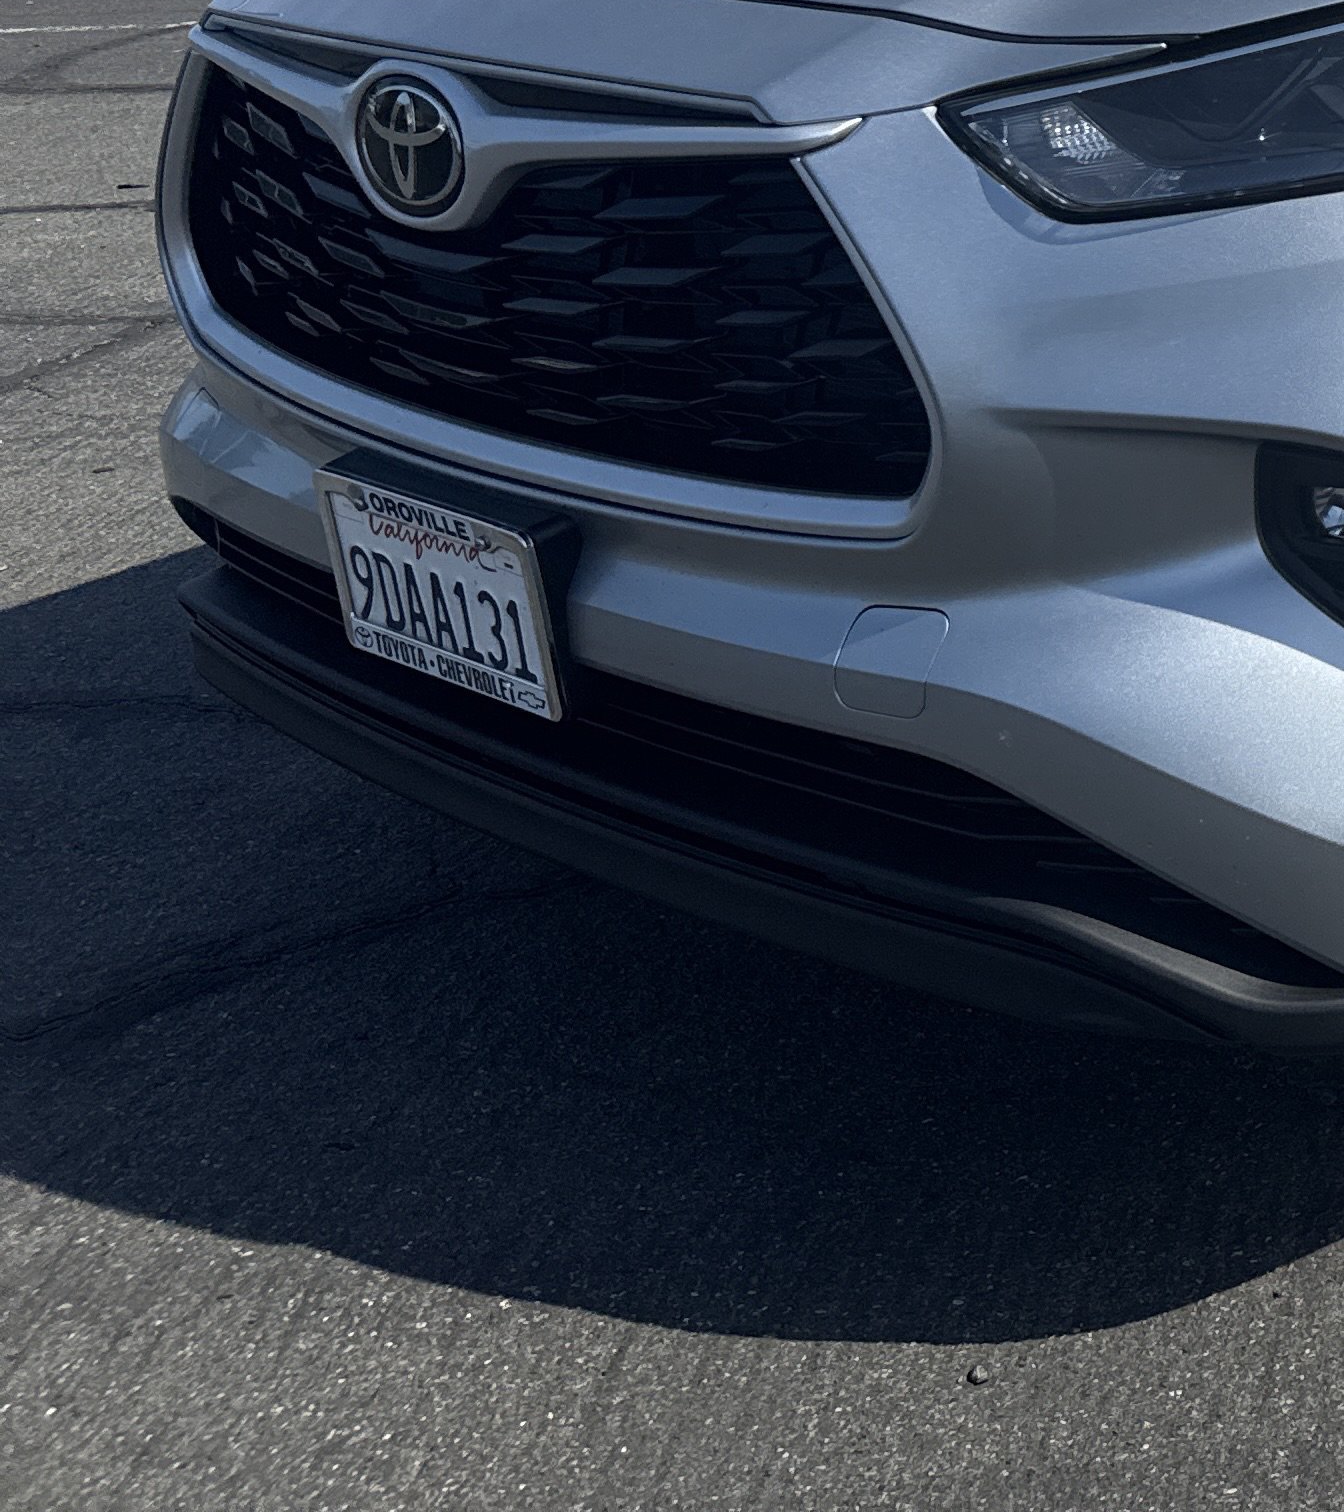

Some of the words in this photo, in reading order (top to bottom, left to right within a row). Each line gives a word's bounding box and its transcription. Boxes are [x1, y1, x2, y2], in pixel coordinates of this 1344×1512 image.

[368, 492, 471, 542] OROVILLE
[350, 544, 538, 685] 9DAA131
[372, 630, 428, 671] TOYOTA
[436, 654, 517, 704] CHEVROLET
